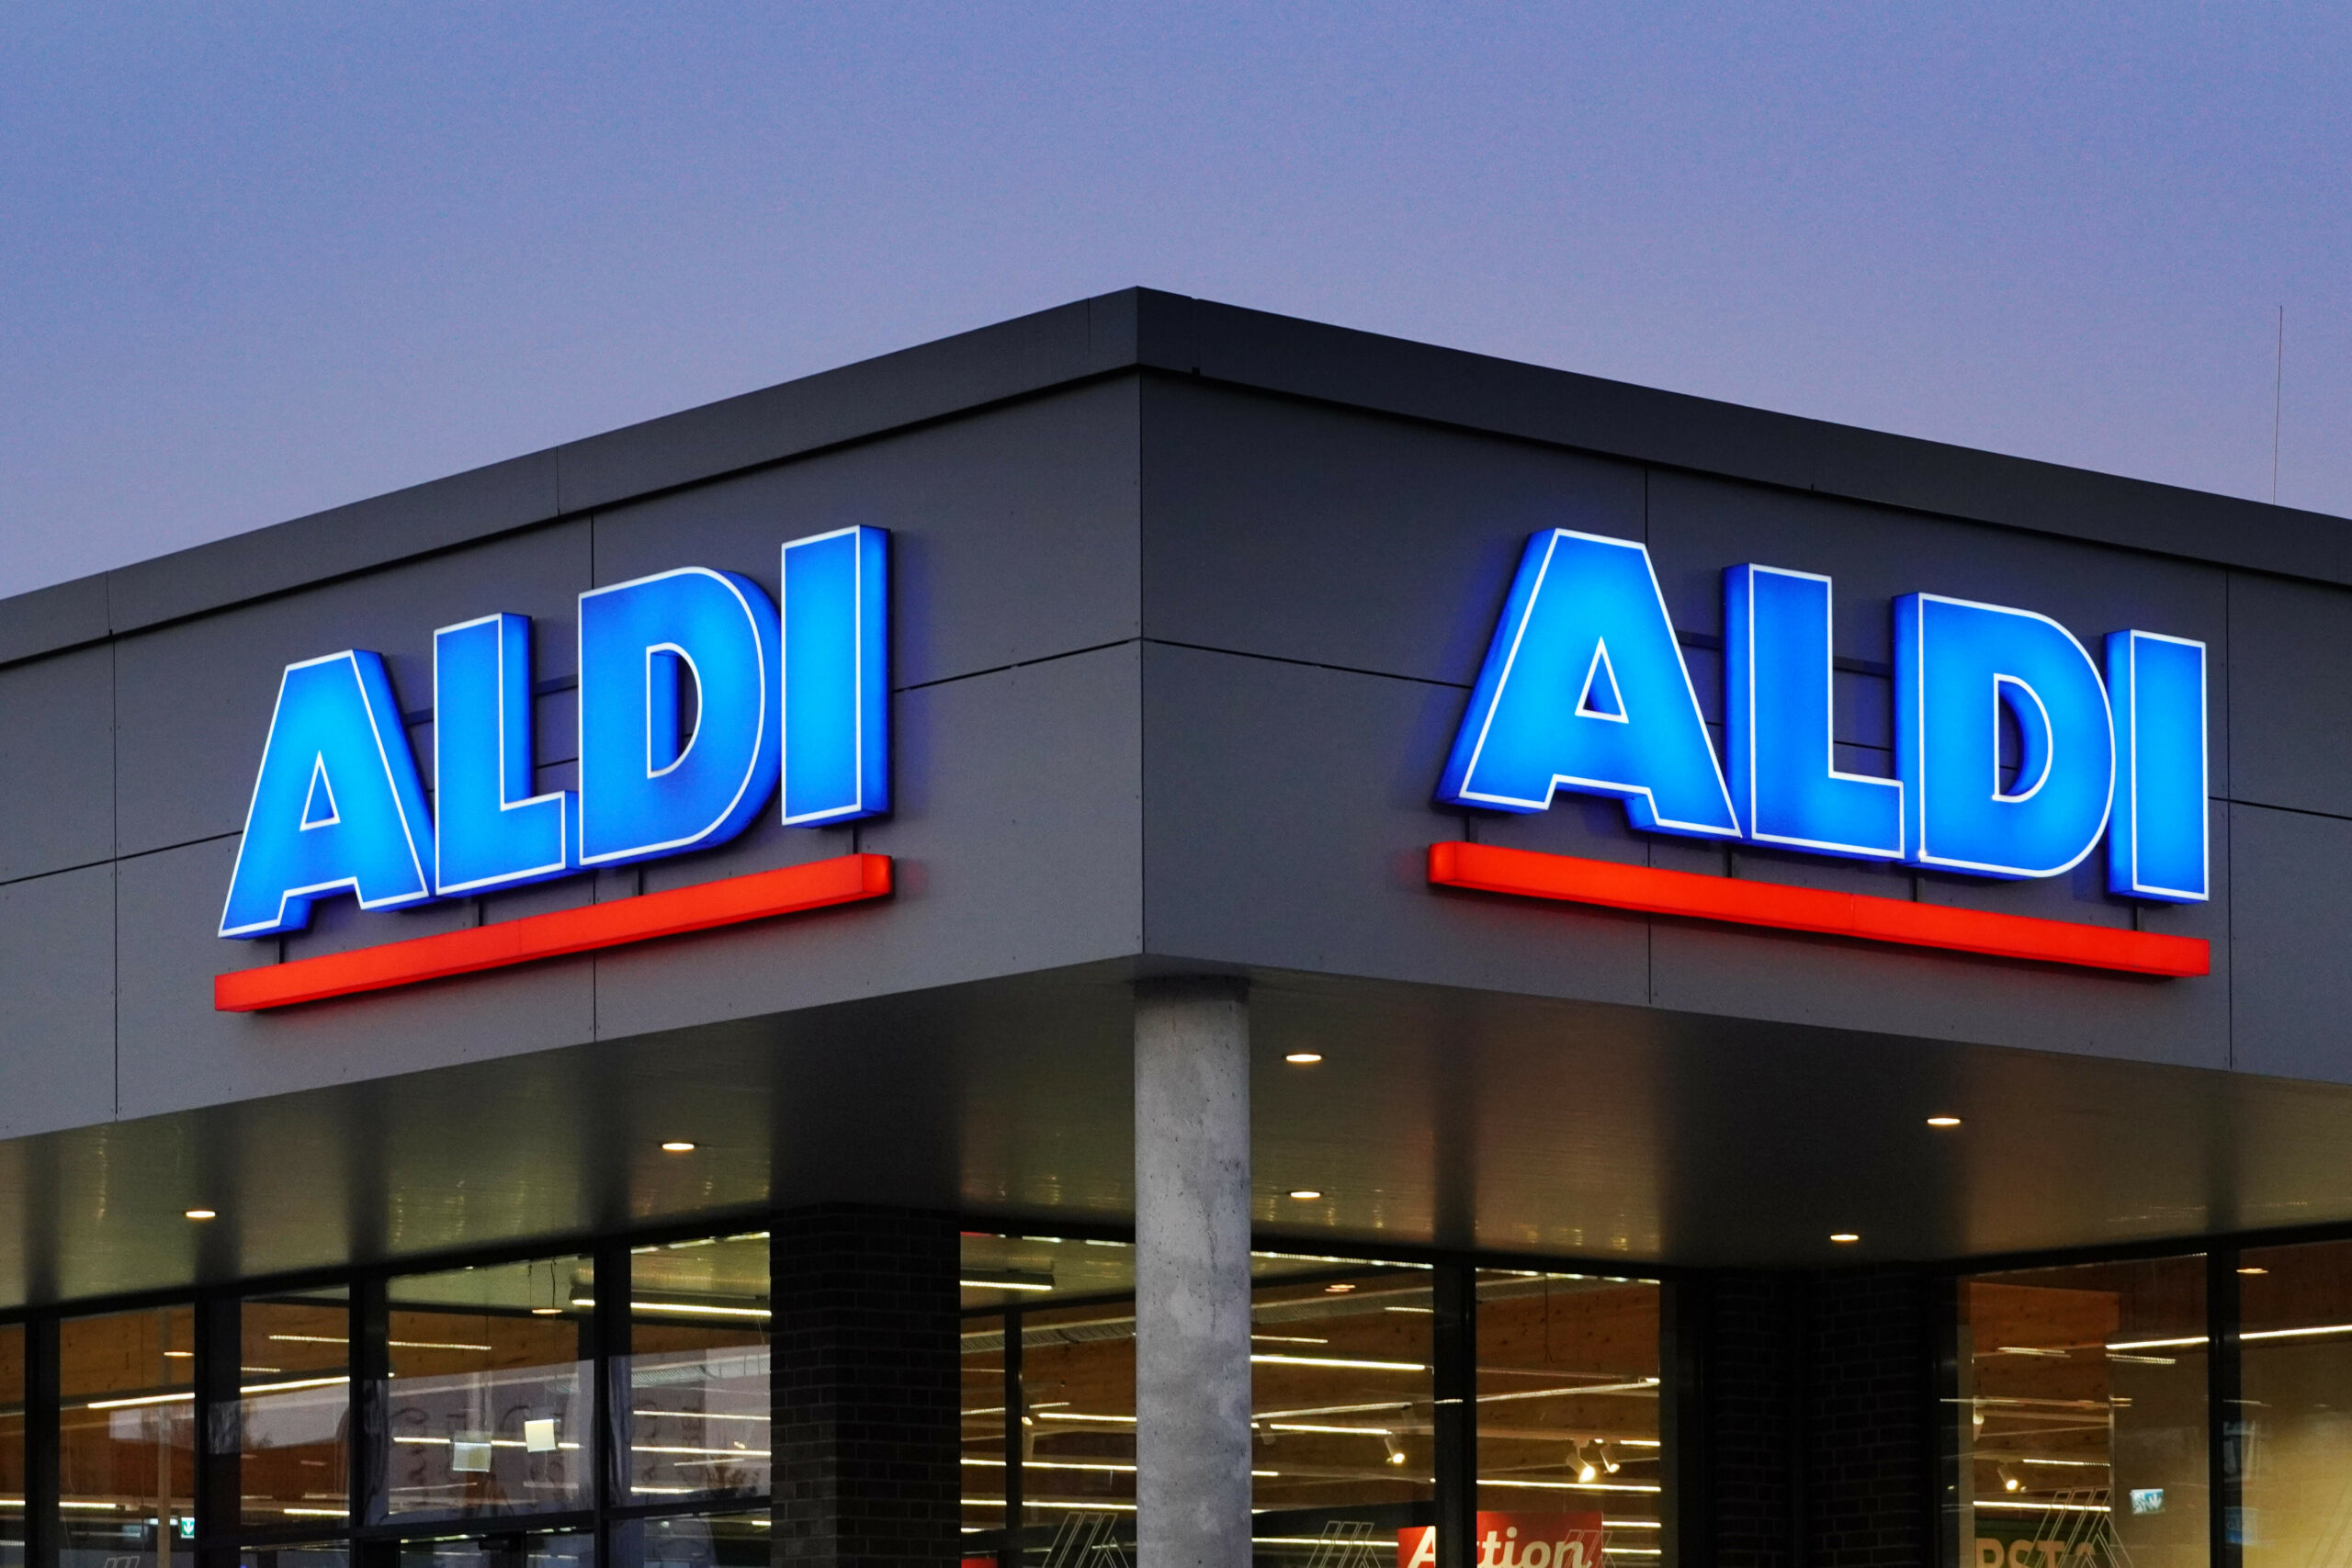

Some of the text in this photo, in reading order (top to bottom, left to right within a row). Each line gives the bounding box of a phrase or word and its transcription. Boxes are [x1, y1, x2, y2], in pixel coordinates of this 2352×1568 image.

[219, 525, 891, 940] ALDI
[1436, 528, 2210, 904] ALDI
[1408, 1526, 1592, 1568] Ation
